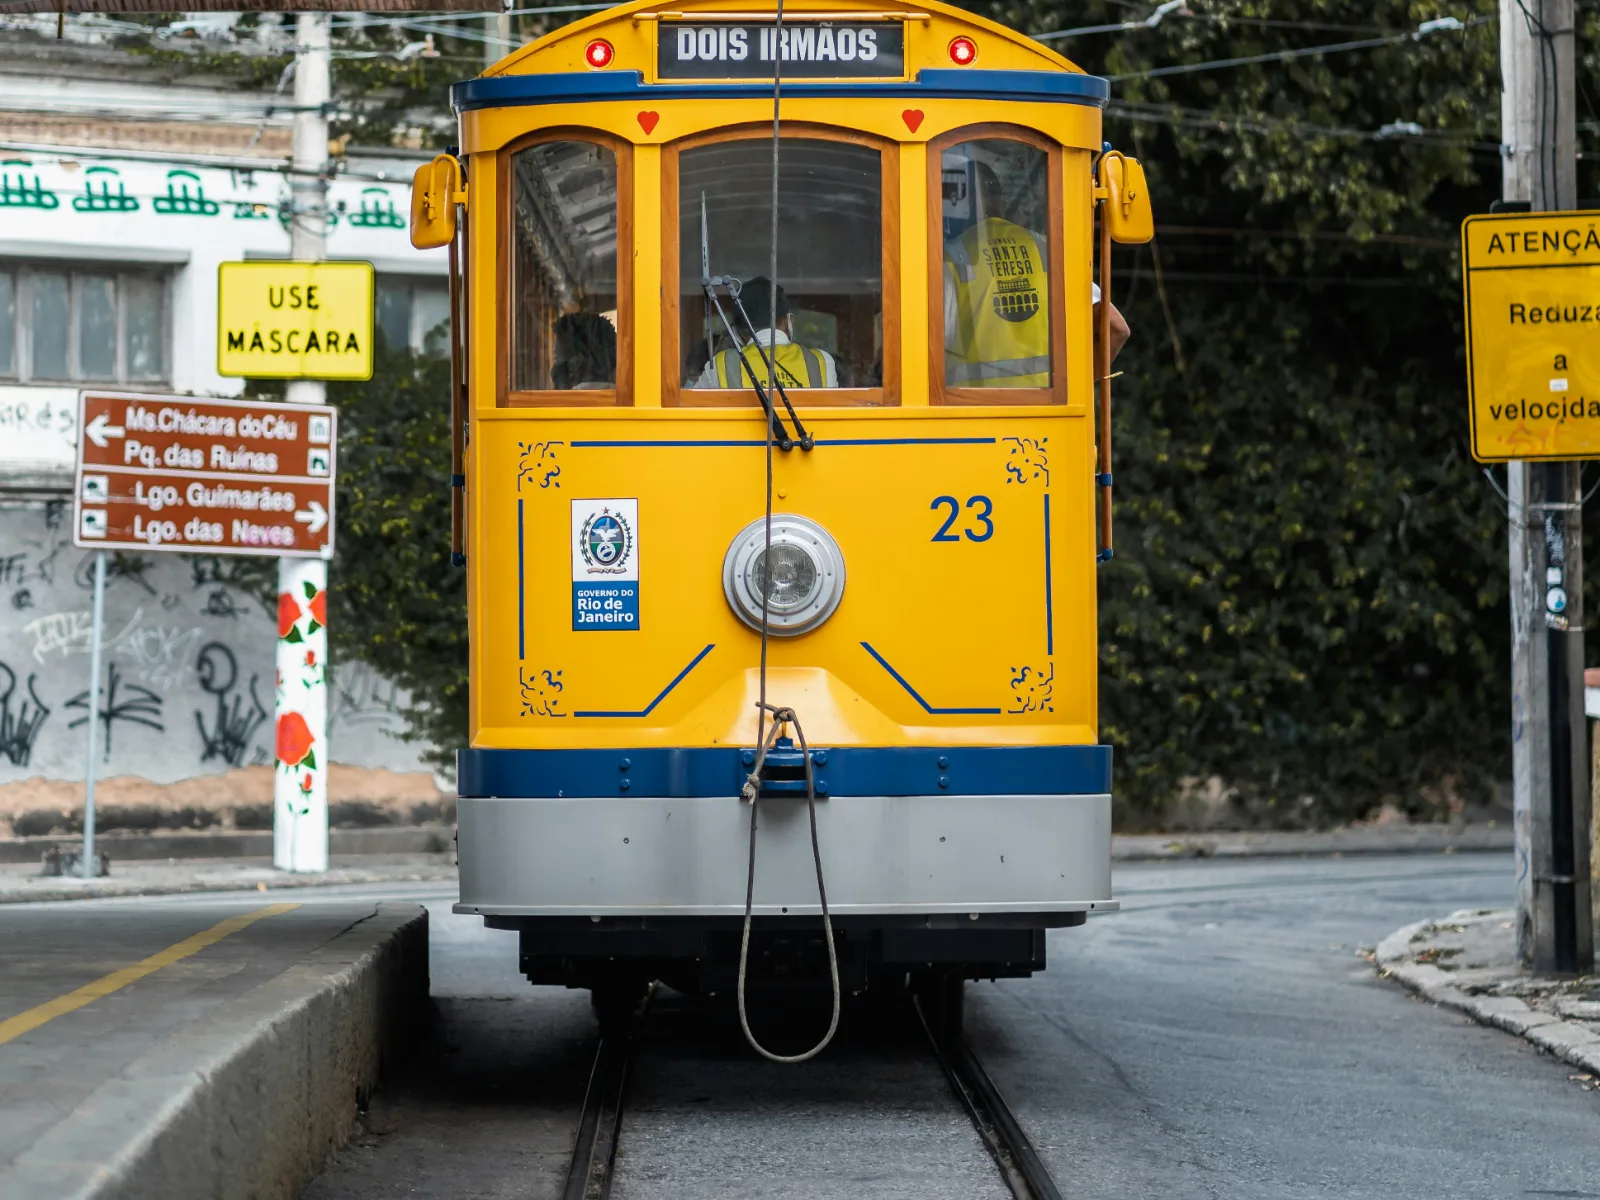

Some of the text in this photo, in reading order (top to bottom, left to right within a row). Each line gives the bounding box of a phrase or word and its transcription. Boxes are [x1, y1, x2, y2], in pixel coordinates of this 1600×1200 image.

[678, 22, 878, 61] DOIS IRMÃOS
[982, 245, 1030, 262] SANTA
[987, 260, 1033, 277] TERESA
[269, 285, 319, 310] USE
[1553, 353, 1568, 371] a
[1489, 396, 1600, 420] velocida
[124, 440, 278, 473] Pq. das Ruínas
[135, 480, 296, 512] Lgo. Guimarães
[133, 514, 295, 546] Lgo. das Neves
[930, 495, 994, 542] 23
[577, 589, 634, 597] GOVERNO DO
[577, 597, 623, 610] Rio de
[577, 610, 634, 623] Janeiro
